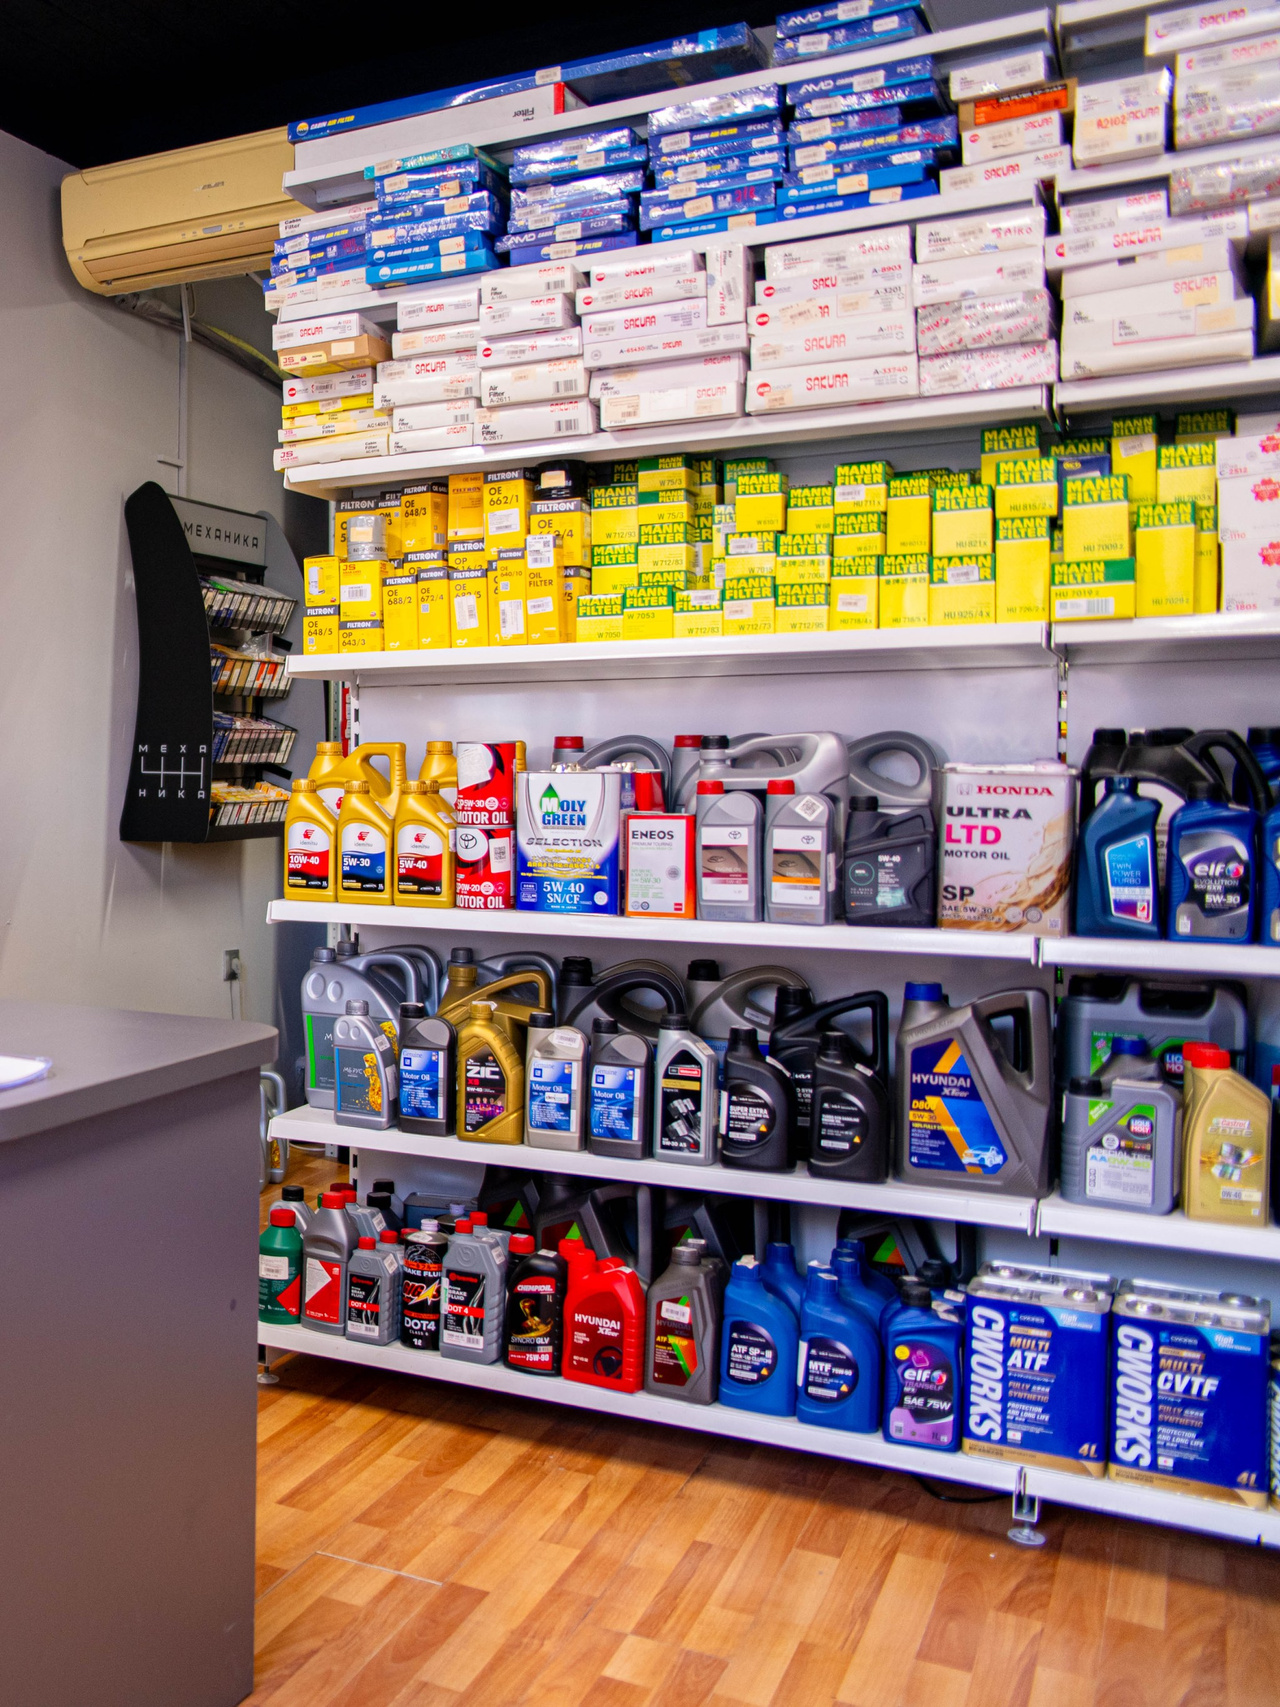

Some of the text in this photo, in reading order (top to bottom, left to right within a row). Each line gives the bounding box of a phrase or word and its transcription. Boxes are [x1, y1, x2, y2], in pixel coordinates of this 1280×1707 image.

[787, 12, 821, 26] AMD
[1200, 8, 1246, 29] SAKURA
[984, 164, 1020, 180] SAKURA
[1113, 227, 1162, 248] SAKURA
[624, 287, 653, 299] SAKURA
[624, 316, 656, 329] SAKURA
[415, 362, 446, 374] SAKURA
[806, 374, 848, 390] SAKURA
[985, 427, 1036, 441] MANN
[985, 437, 1036, 452] FILTER
[1161, 445, 1213, 457] MANN
[1000, 460, 1054, 472] MANN
[1161, 455, 1213, 468] FILTER
[837, 463, 882, 475] MANN
[488, 471, 519, 481] FILTRON
[738, 474, 779, 484] MANN
[837, 474, 882, 485] FILTER
[1000, 471, 1054, 485] FILTER
[738, 483, 778, 494] FILTER
[1066, 477, 1124, 490] MANN
[404, 486, 427, 494] FILTRON
[489, 487, 502, 496] OE
[594, 487, 636, 497] MANN
[489, 495, 519, 506] 662/1
[594, 496, 636, 507] FILTER
[790, 497, 832, 507] FILTER
[1067, 490, 1124, 504] FILTER
[340, 501, 375, 509] FILTRON
[537, 503, 574, 512] FILTRON
[936, 497, 988, 511] FILTER
[405, 508, 427, 517] 648/3
[184, 523, 258, 548] МЕХАНИКА
[408, 552, 439, 560] FILTRON
[388, 596, 412, 605] 688/2
[421, 594, 443, 602] 672/4
[307, 607, 334, 615] FILTRON
[308, 628, 332, 636] 648/5
[342, 639, 365, 647] 643/3
[976, 784, 1054, 797] HONDA
[542, 798, 586, 813] MOLY
[492, 811, 508, 824] OIL
[947, 807, 1032, 820] ULTRA
[542, 814, 586, 826] GREEN
[632, 830, 674, 839] ENEOS
[946, 824, 1001, 845] LTD
[526, 838, 602, 847] SELECTION
[290, 855, 319, 864] 10W-40
[945, 850, 1010, 860] MOTOR OIL
[343, 858, 370, 866] 5W-30
[399, 860, 427, 868] 5W-40
[1195, 862, 1224, 876] elf
[543, 882, 584, 893] 5W-40
[943, 885, 974, 901] SP
[547, 894, 580, 903] SN/CF
[1205, 895, 1240, 904] 5W-30
[963, 906, 993, 914] 5W-30
[466, 1066, 500, 1079] ZIC
[912, 1073, 970, 1088] HYUNDAI
[1130, 1125, 1151, 1133] MOLY
[405, 1317, 436, 1330] DOT4
[575, 1313, 620, 1329] HYUNDAI
[1010, 1338, 1049, 1350] MULTI
[1007, 1352, 1049, 1369] ATF
[904, 1370, 930, 1381] elf
[968, 1306, 1005, 1441] CWORKS
[1157, 1373, 1218, 1396] CVTF
[1115, 1324, 1153, 1466] CWORKS
[904, 1396, 951, 1411] SAE 75W
[1079, 1444, 1098, 1458] 4L
